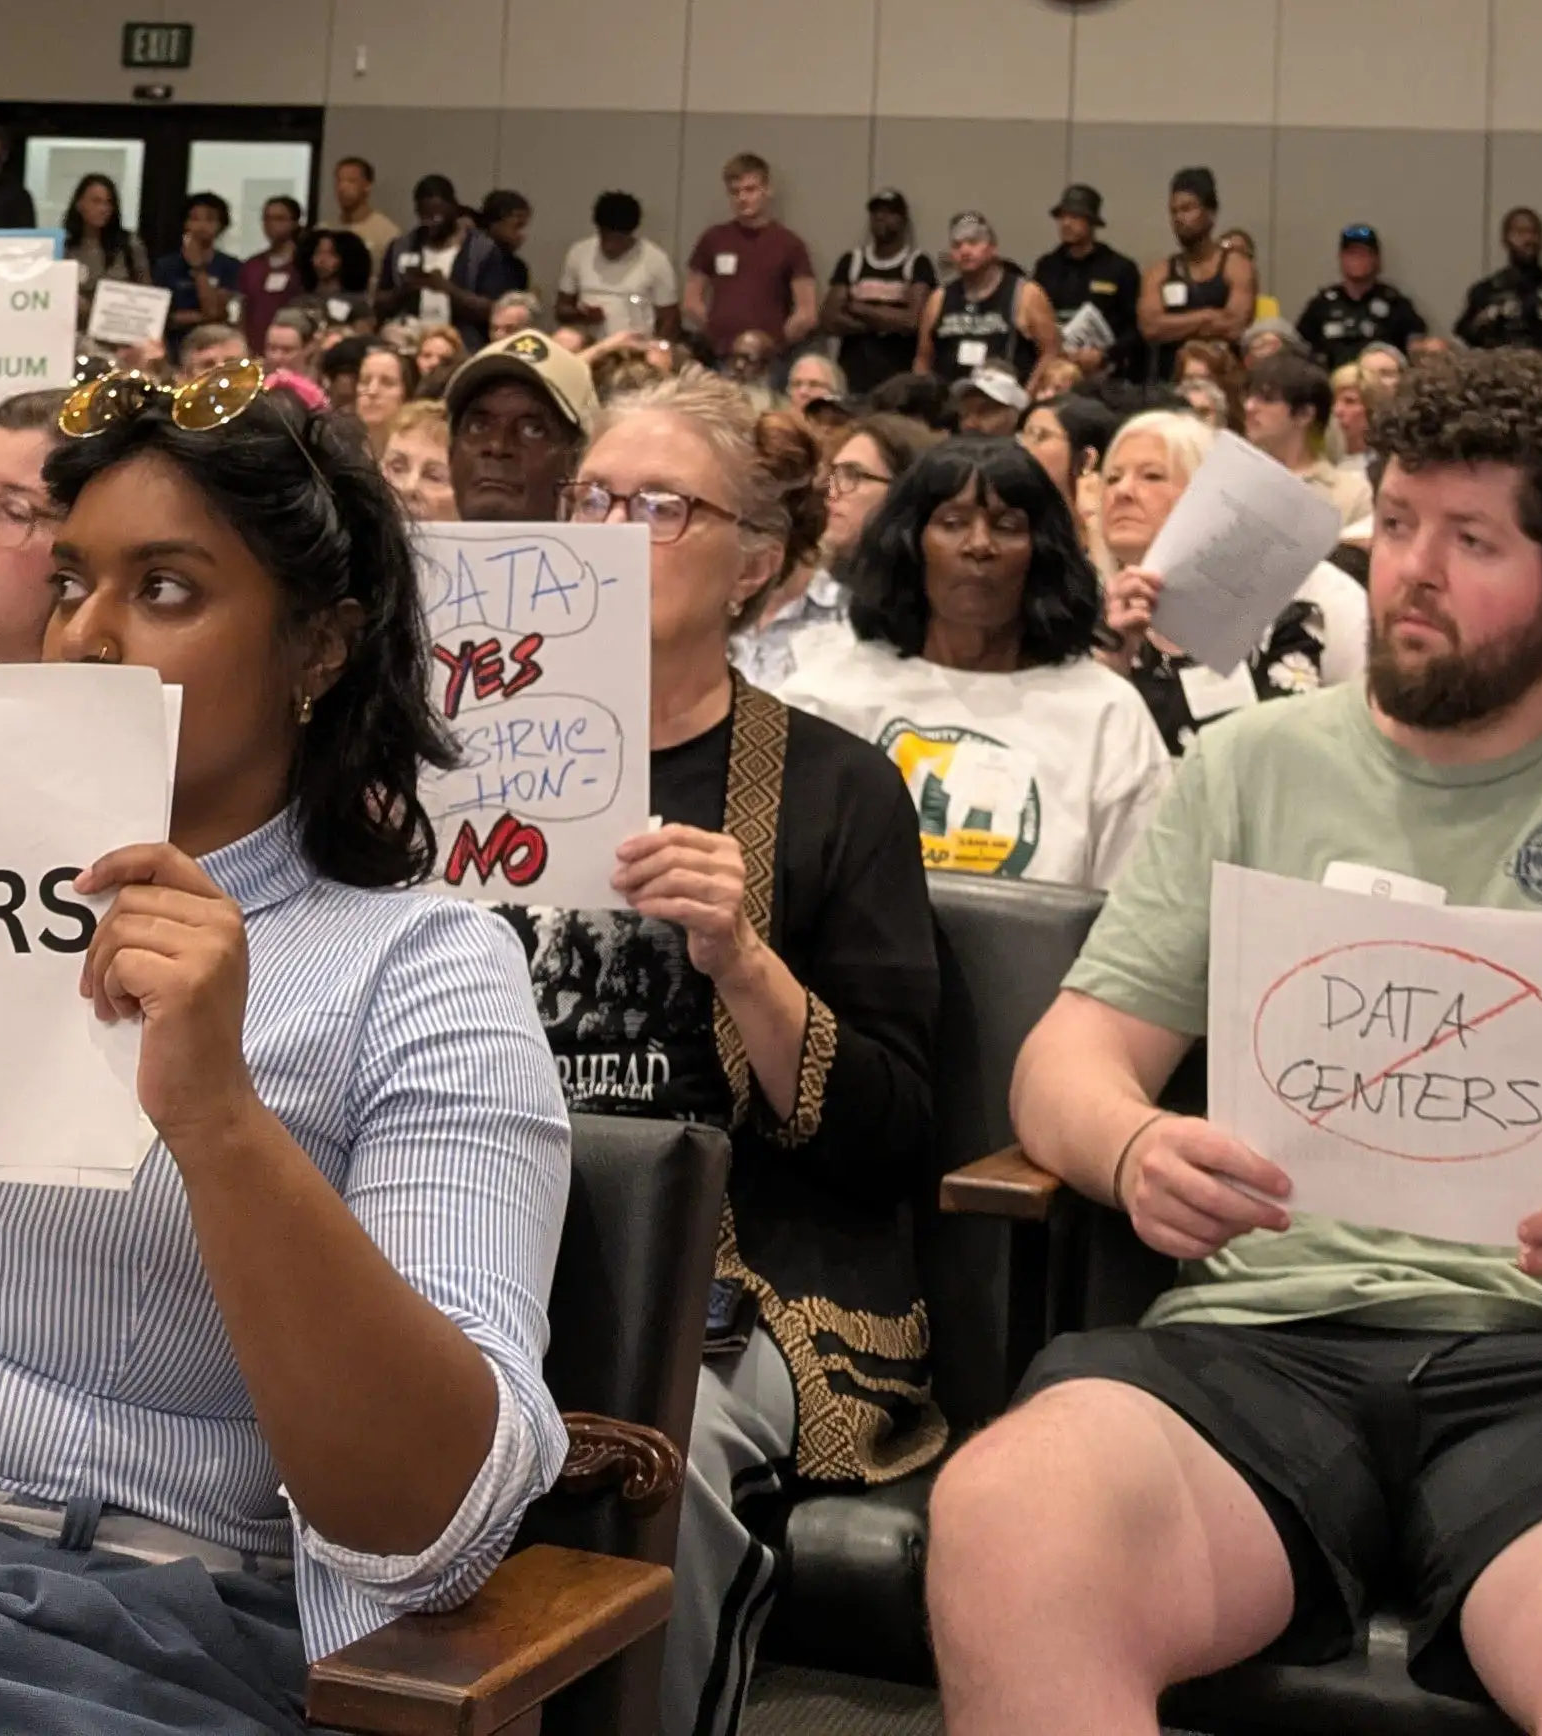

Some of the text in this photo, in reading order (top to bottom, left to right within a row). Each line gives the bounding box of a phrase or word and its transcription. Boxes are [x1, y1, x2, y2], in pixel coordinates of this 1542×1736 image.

[10, 290, 51, 311] ON
[433, 632, 545, 720] YES
[444, 809, 549, 887] NO
[1320, 974, 1477, 1052] DATA
